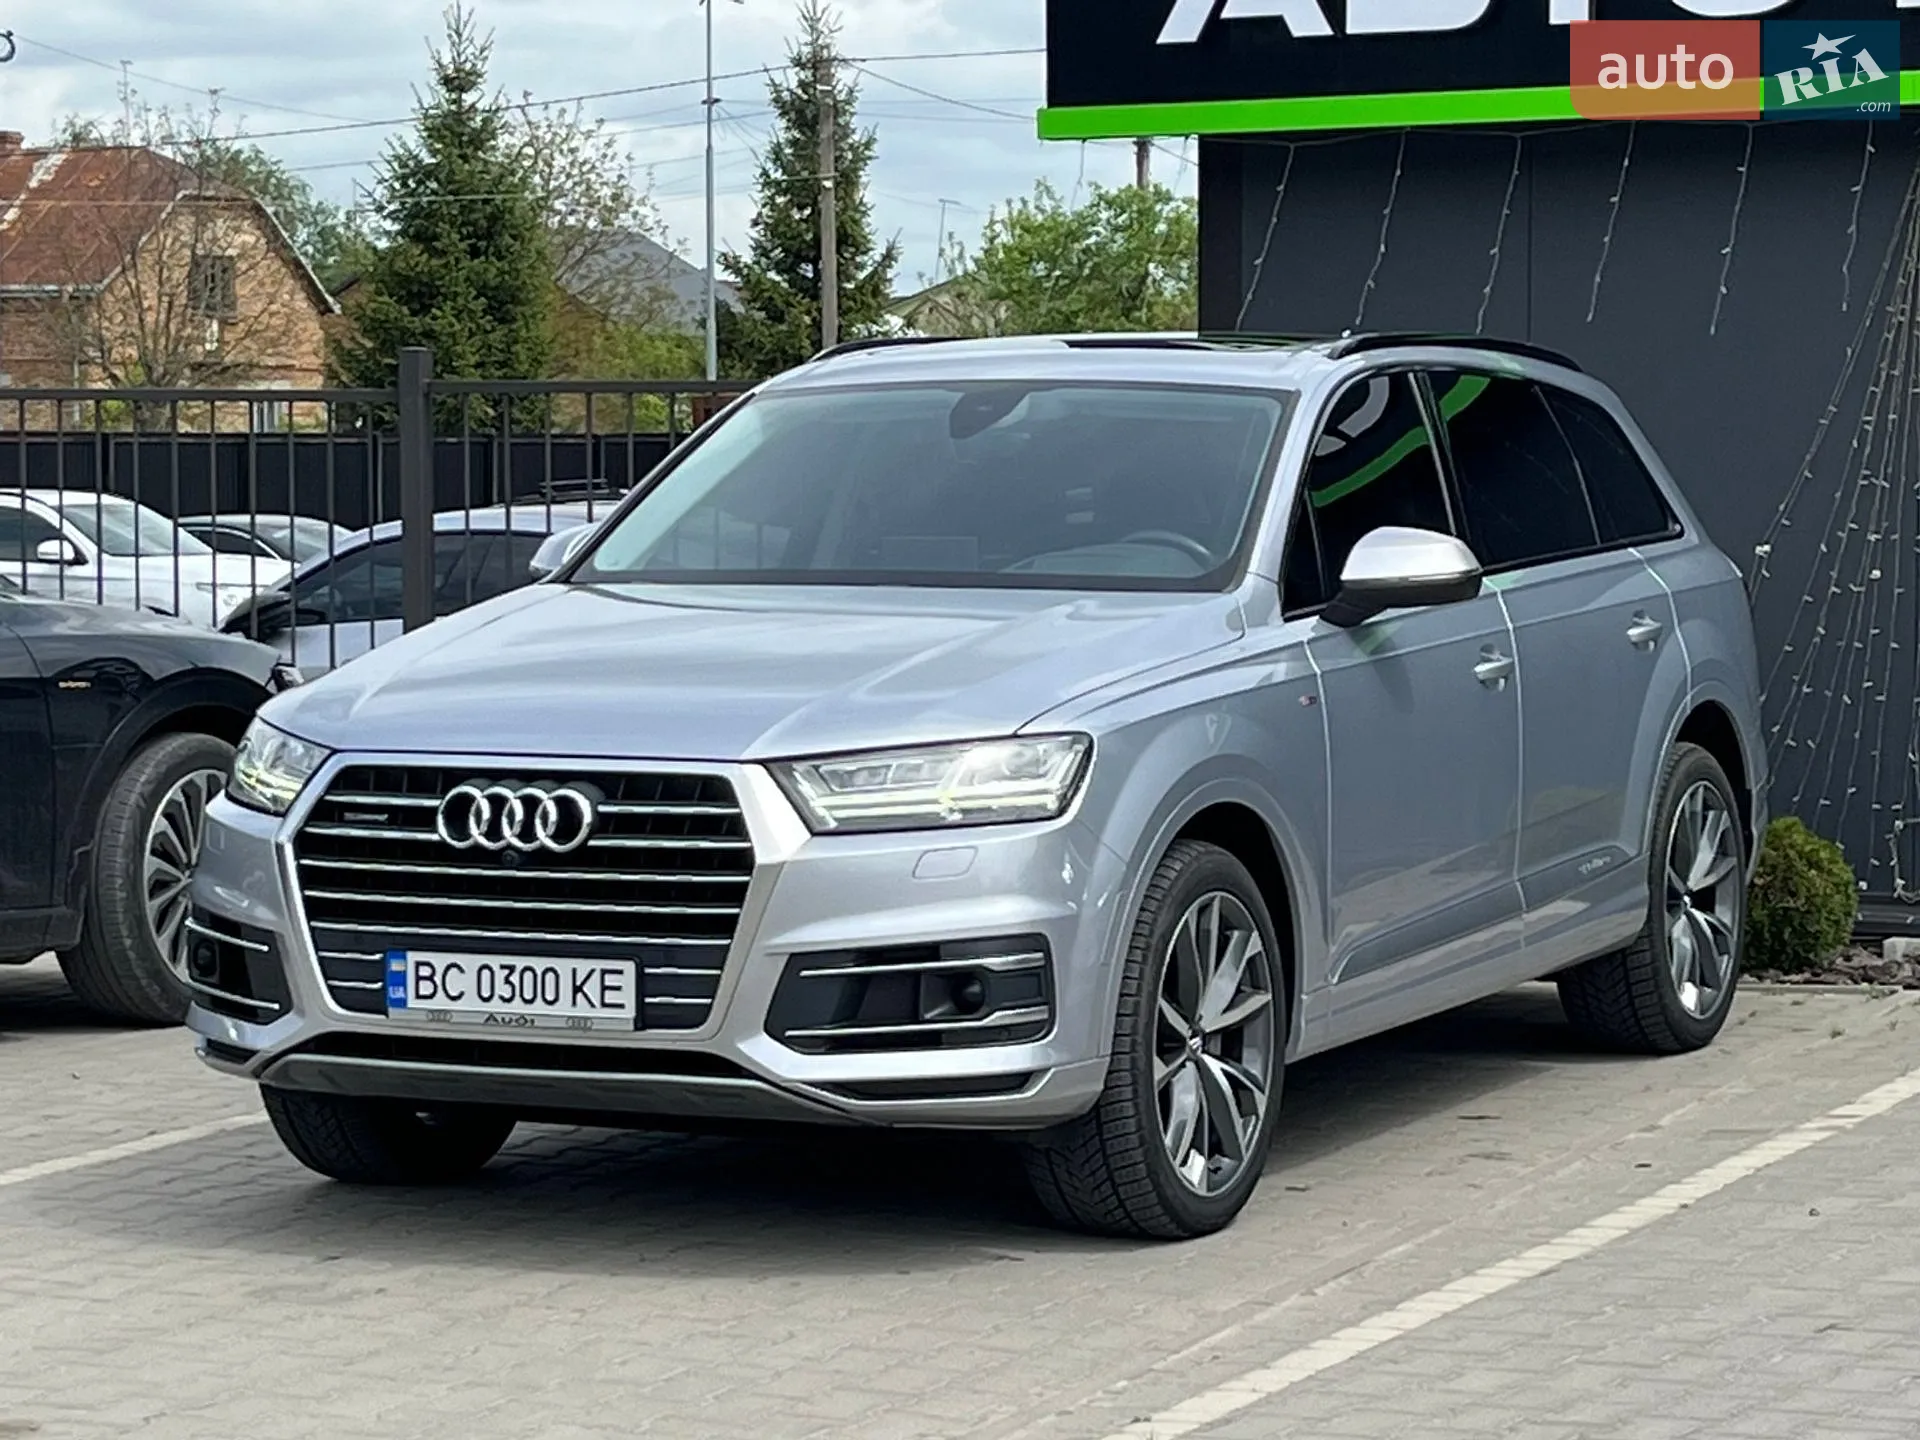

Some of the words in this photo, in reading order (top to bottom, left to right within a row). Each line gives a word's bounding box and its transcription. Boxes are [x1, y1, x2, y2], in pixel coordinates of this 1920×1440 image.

[414, 960, 465, 1001] BC
[476, 963, 560, 1006] 0300
[571, 967, 626, 1009] KE
